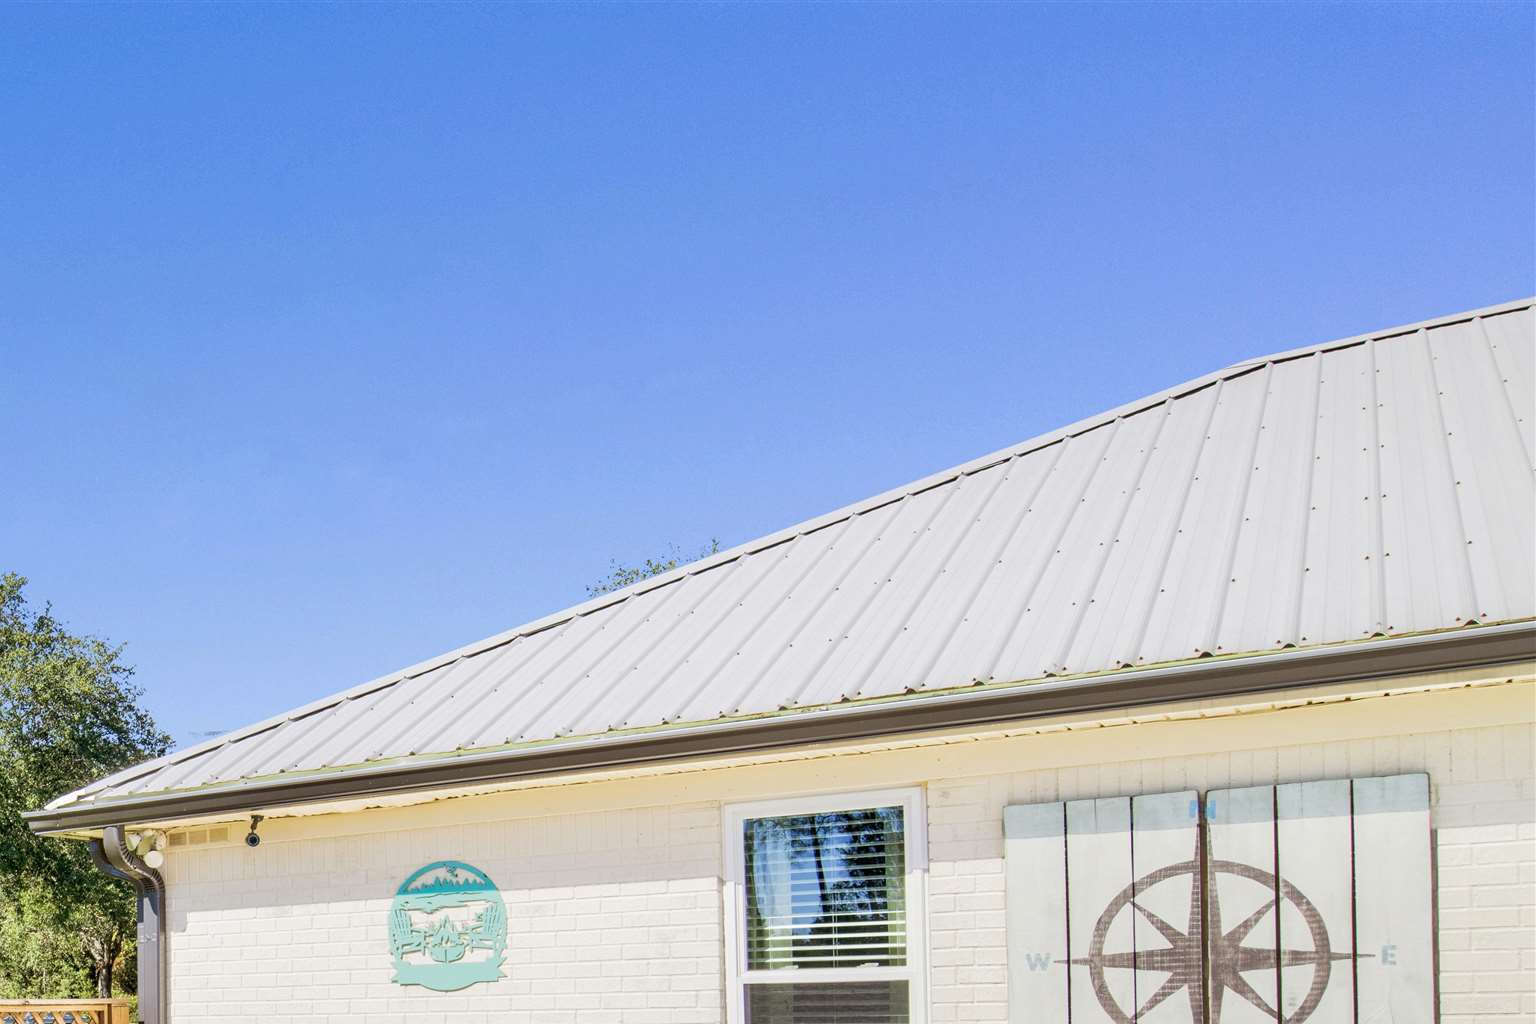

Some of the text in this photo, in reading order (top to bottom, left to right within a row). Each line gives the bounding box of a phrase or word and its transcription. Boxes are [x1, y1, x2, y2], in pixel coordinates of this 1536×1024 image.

[1188, 799, 1217, 819] N
[1024, 952, 1052, 971] W
[1381, 944, 1397, 966] E
